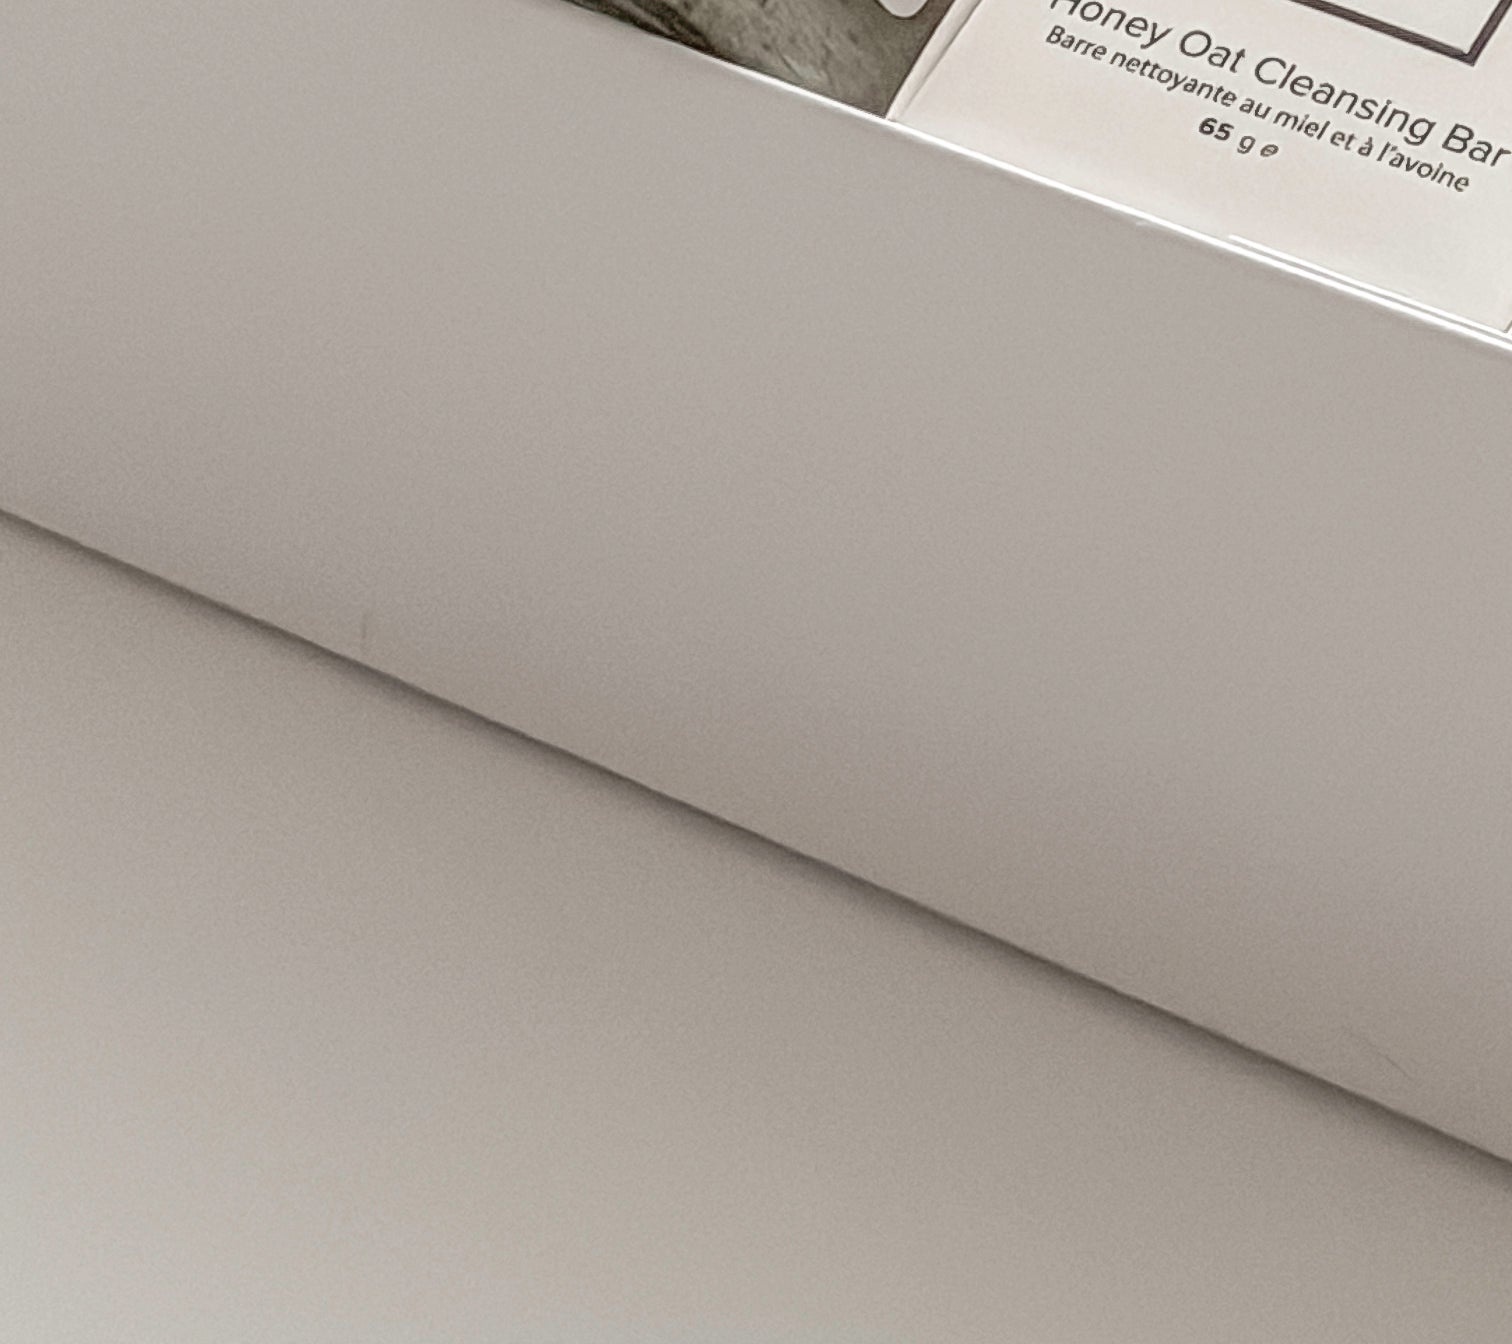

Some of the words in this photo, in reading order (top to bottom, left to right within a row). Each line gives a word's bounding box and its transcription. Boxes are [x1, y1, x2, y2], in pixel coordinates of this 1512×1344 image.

[1044, 24, 1108, 62] Barre
[1110, 45, 1238, 108] nettoyante
[1238, 94, 1271, 119] au
[1272, 106, 1330, 143] miel
[1329, 126, 1357, 152] et
[1356, 133, 1376, 158] à
[1178, 28, 1248, 75] Oat
[1253, 55, 1437, 147] Cleansing
[1197, 116, 1233, 143] 65
[1235, 133, 1257, 157] g
